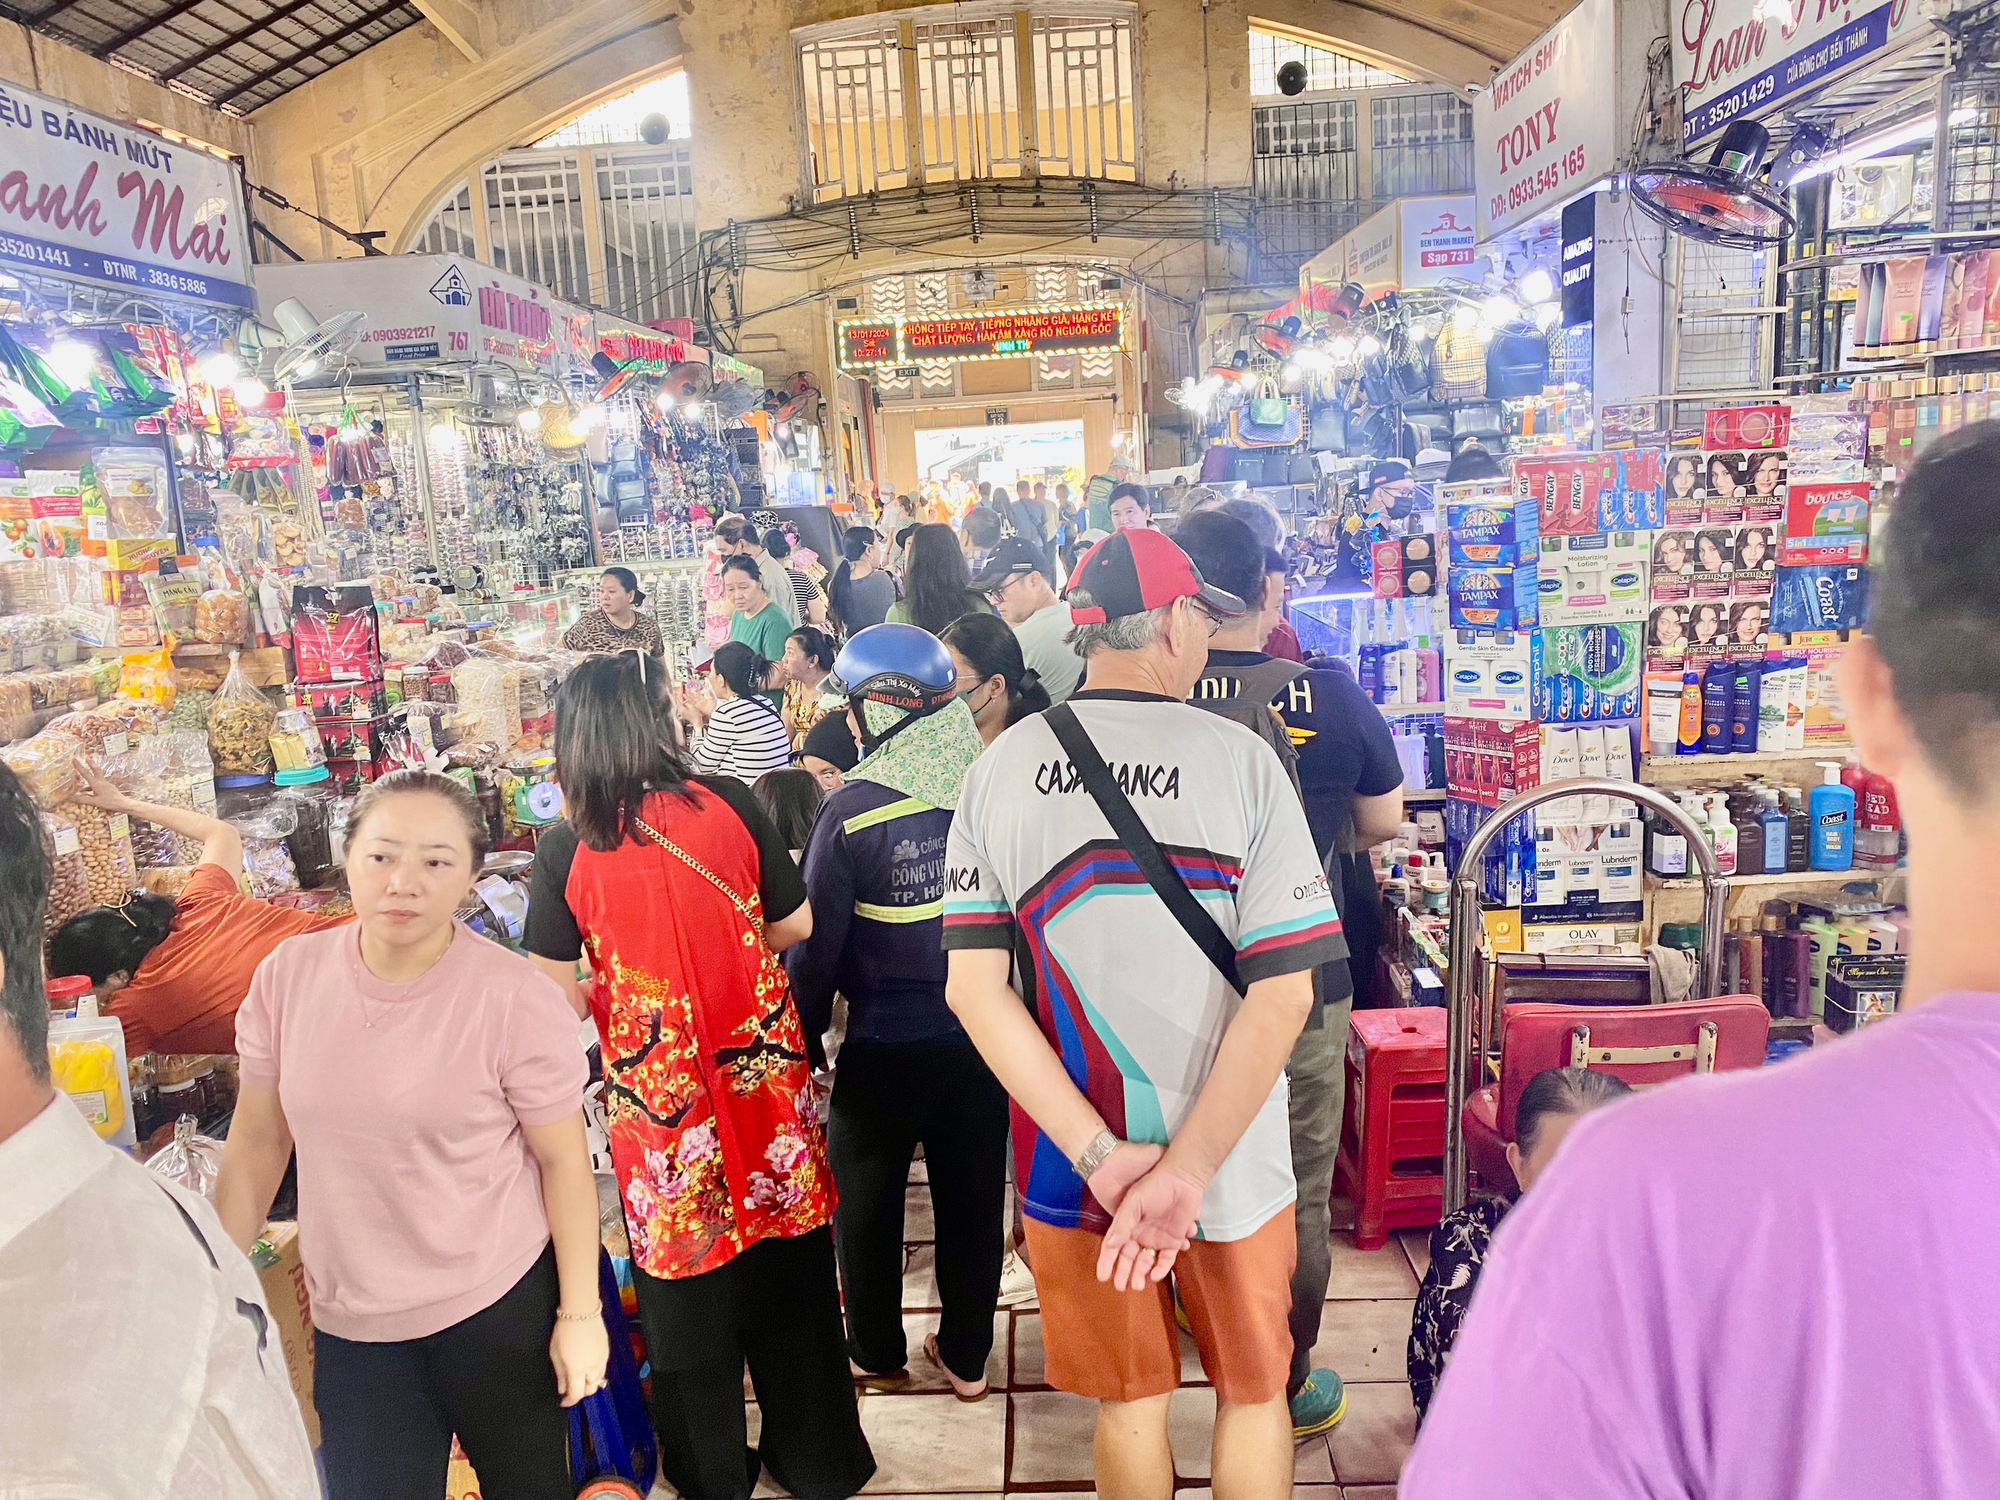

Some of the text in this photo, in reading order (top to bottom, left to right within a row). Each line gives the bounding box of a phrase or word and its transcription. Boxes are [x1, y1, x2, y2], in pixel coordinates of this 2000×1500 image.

[1492, 26, 1573, 112] WATCH SHOP
[1708, 73, 1775, 127] 35201429
[41, 109, 119, 156] BÁNH
[124, 138, 173, 174] MỨT
[1497, 97, 1562, 175] TONY
[1562, 144, 1585, 180] 165
[117, 170, 231, 266] Mai
[1452, 236, 1474, 246] MARKET
[1563, 235, 1593, 262] AMAZING
[1427, 250, 1469, 266] Sạp 731
[103, 259, 138, 281] ĐTNR
[1563, 262, 1591, 287] QUALITY
[373, 325, 436, 342] 0903921217
[903, 322, 935, 335] KHÔNG
[448, 331, 469, 351] 767
[853, 348, 887, 358] 10:27:14
[898, 368, 918, 376] EXIT
[1790, 468, 1819, 476] Crest
[1443, 490, 1455, 499] ICY
[1483, 486, 1495, 495] ICY
[1546, 474, 1555, 512] BENGAY
[1572, 472, 1582, 510] BENGAY
[1746, 496, 1784, 504] EXCELLENCE
[1805, 489, 1852, 506] bounce
[1461, 525, 1501, 539] TAMPAX
[1567, 554, 1609, 562] Moisturizing
[1612, 576, 1637, 585] Cetaphil
[1693, 573, 1731, 582] EXCELLENCE
[1735, 571, 1773, 579] EXCELLENCE
[1460, 590, 1499, 602] TAMPAX
[1816, 577, 1839, 622] Coast
[1558, 627, 1568, 666] scope
[1688, 646, 1727, 654] EXCELLENCE
[1728, 644, 1767, 653] EXCELLENCE
[1781, 648, 1807, 657] DEEPLY
[1811, 653, 1823, 661] DRY
[1497, 674, 1520, 682] Cetaphil
[1532, 643, 1542, 707] Cetaphil
[867, 690, 924, 708] MINH LONG
[1552, 755, 1575, 764] Dove
[1579, 753, 1600, 762] Dove
[1605, 752, 1627, 761] Dove
[1461, 785, 1478, 794] Whiter
[1865, 791, 1886, 805] BED
[1821, 812, 1845, 825] Coast
[920, 836, 946, 854] CÔNG
[1568, 859, 1594, 867] Lubriderm
[1601, 855, 1638, 864] Lubriderm
[891, 862, 927, 887] CÔNG
[891, 890, 920, 904] TP.
[1568, 929, 1600, 940] OLAY
